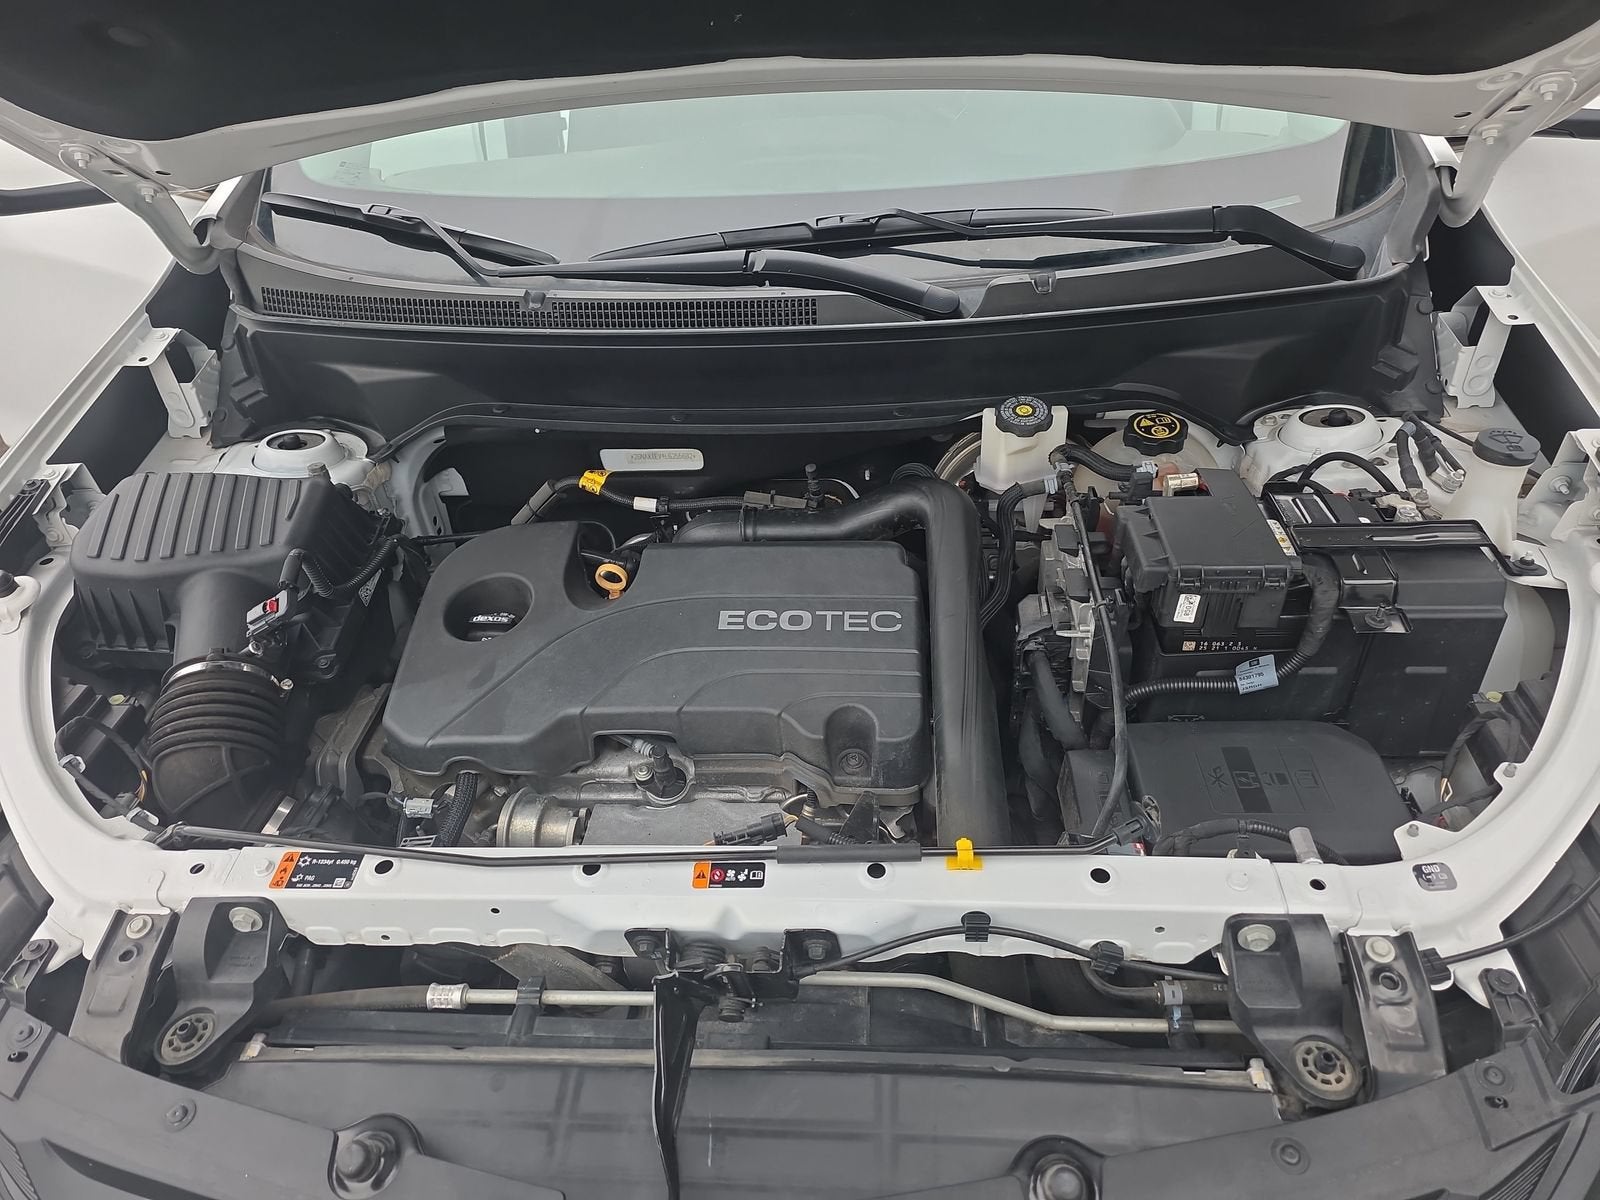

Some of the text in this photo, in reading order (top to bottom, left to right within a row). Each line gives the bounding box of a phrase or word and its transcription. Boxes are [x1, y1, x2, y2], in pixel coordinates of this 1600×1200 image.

[472, 615, 509, 623] dexos
[717, 609, 903, 632] ECOTEC
[1421, 864, 1440, 874] GND
